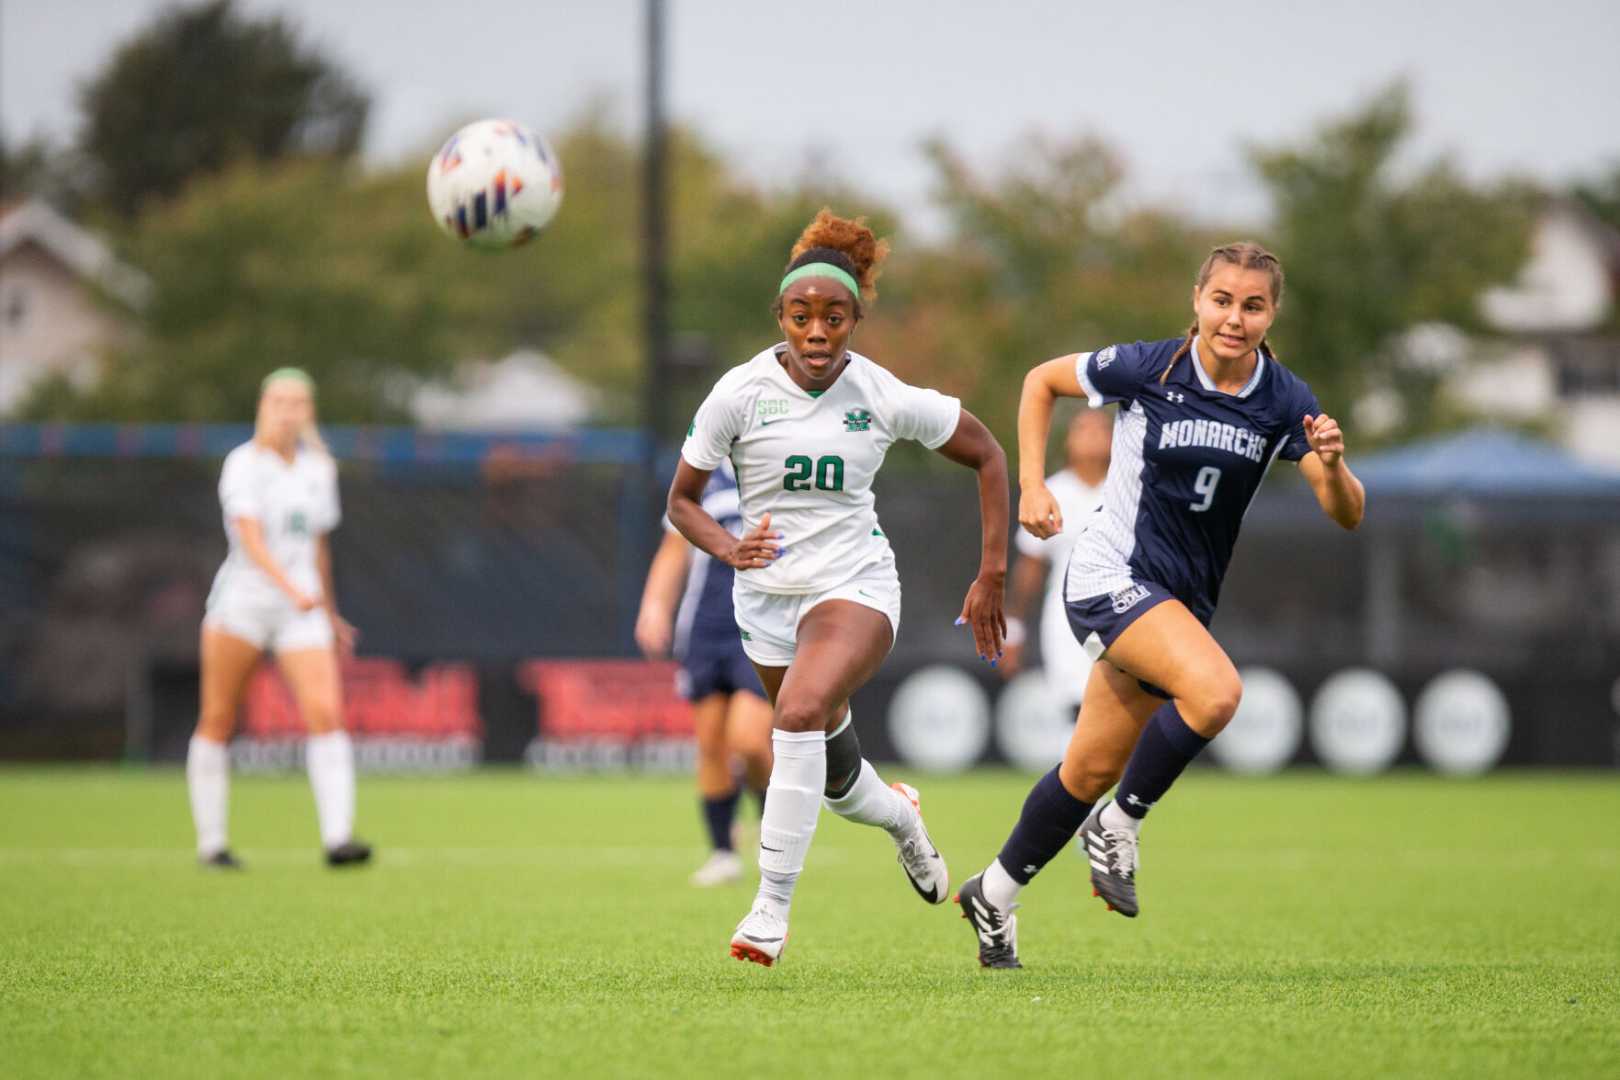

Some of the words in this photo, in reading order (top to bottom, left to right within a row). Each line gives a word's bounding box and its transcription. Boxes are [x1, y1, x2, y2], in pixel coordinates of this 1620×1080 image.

[758, 400, 789, 415] SBC
[1159, 419, 1267, 463] MONARCHS
[783, 455, 845, 491] 20
[1189, 466, 1221, 512] 9
